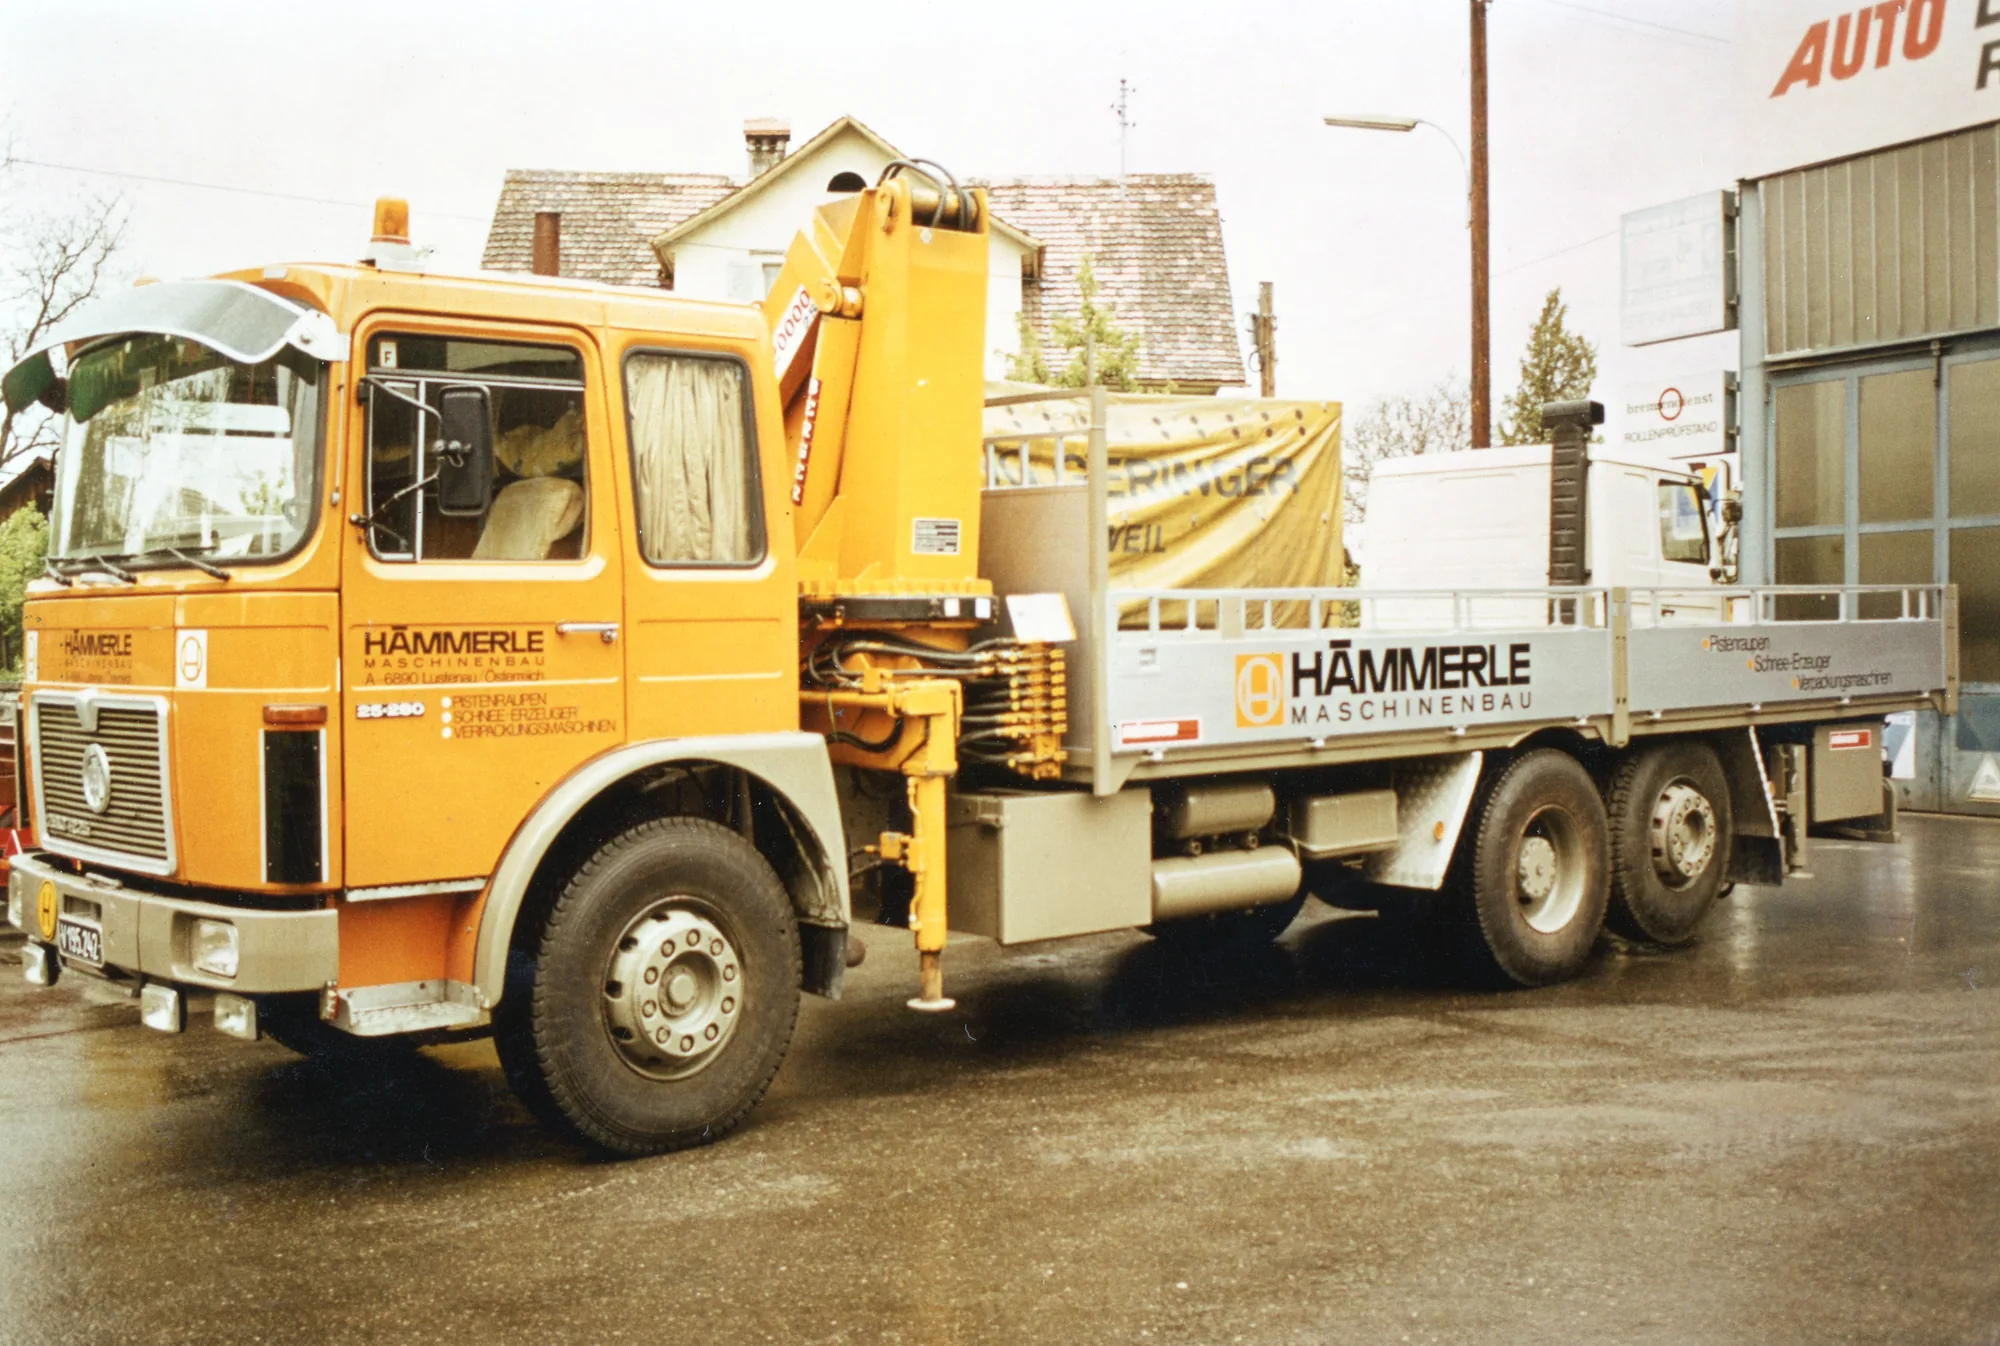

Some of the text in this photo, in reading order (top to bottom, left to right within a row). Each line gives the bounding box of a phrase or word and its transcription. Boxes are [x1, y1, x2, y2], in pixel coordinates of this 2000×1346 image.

[1769, 0, 1946, 98] AUTO
[1709, 634, 1770, 652] Pistenraupen
[363, 656, 545, 669] MASCHINENBAU
[452, 693, 547, 708] PISTENRAUPEN
[1291, 691, 1533, 726] MASCHINENBAU
[454, 720, 616, 738] VERPACKUNGSMASCHINEN
